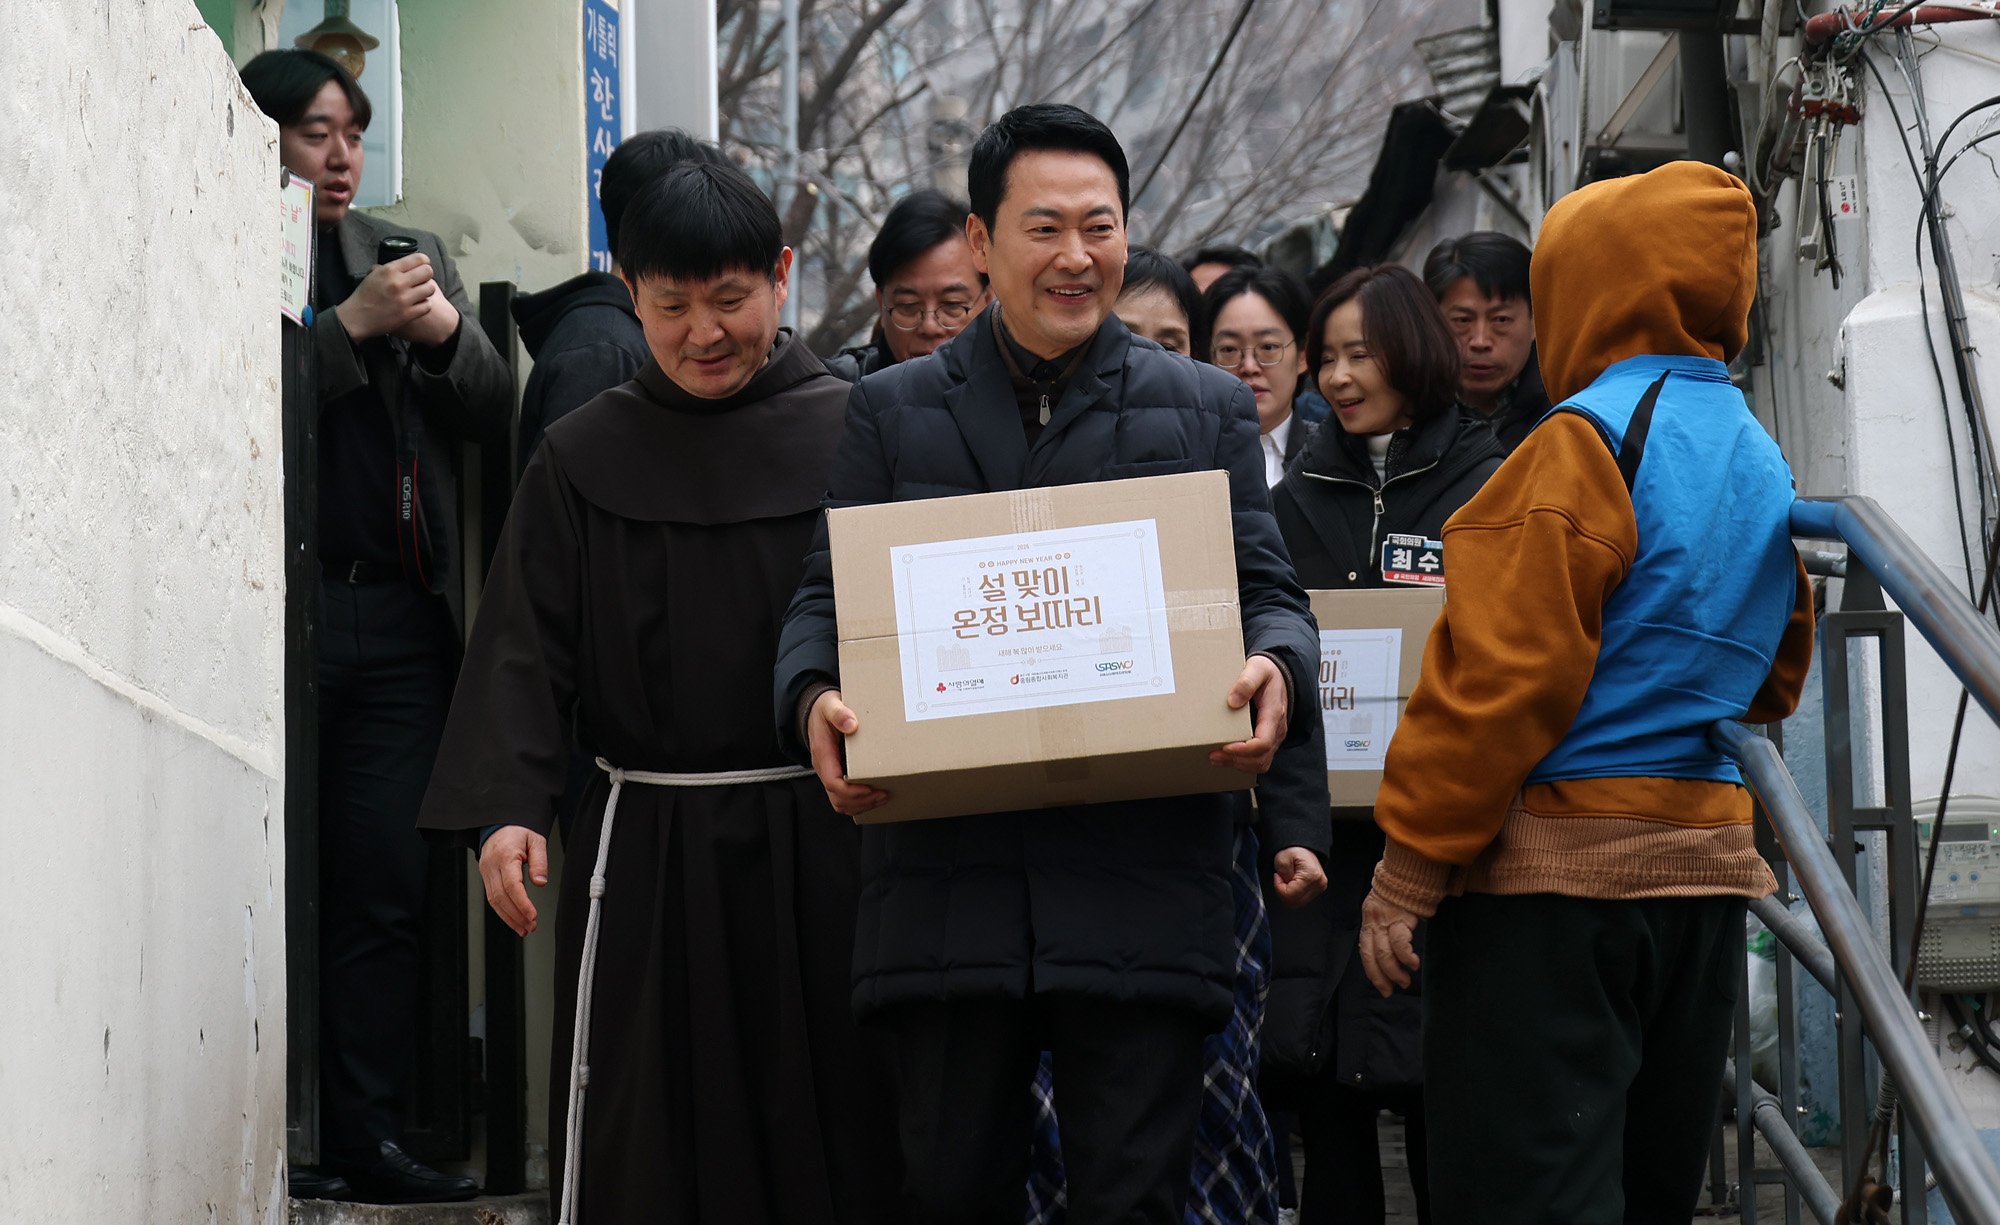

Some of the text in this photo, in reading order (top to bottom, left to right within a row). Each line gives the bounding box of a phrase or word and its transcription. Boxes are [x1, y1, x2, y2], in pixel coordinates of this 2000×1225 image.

[587, 6, 617, 69] 가톨릭
[1841, 191, 1847, 201] LG
[402, 475, 412, 520] EOS R10
[1391, 536, 1422, 547] 국회의원
[996, 558, 1018, 567] HAPPY
[978, 572, 1007, 602] 설
[1011, 566, 1070, 599] 맞이
[952, 595, 1102, 639] 온정 보따리
[1020, 646, 1035, 655] 많이
[1035, 643, 1063, 654] 받으세요
[1320, 660, 1337, 683] 이
[1319, 686, 1355, 710] 따리
